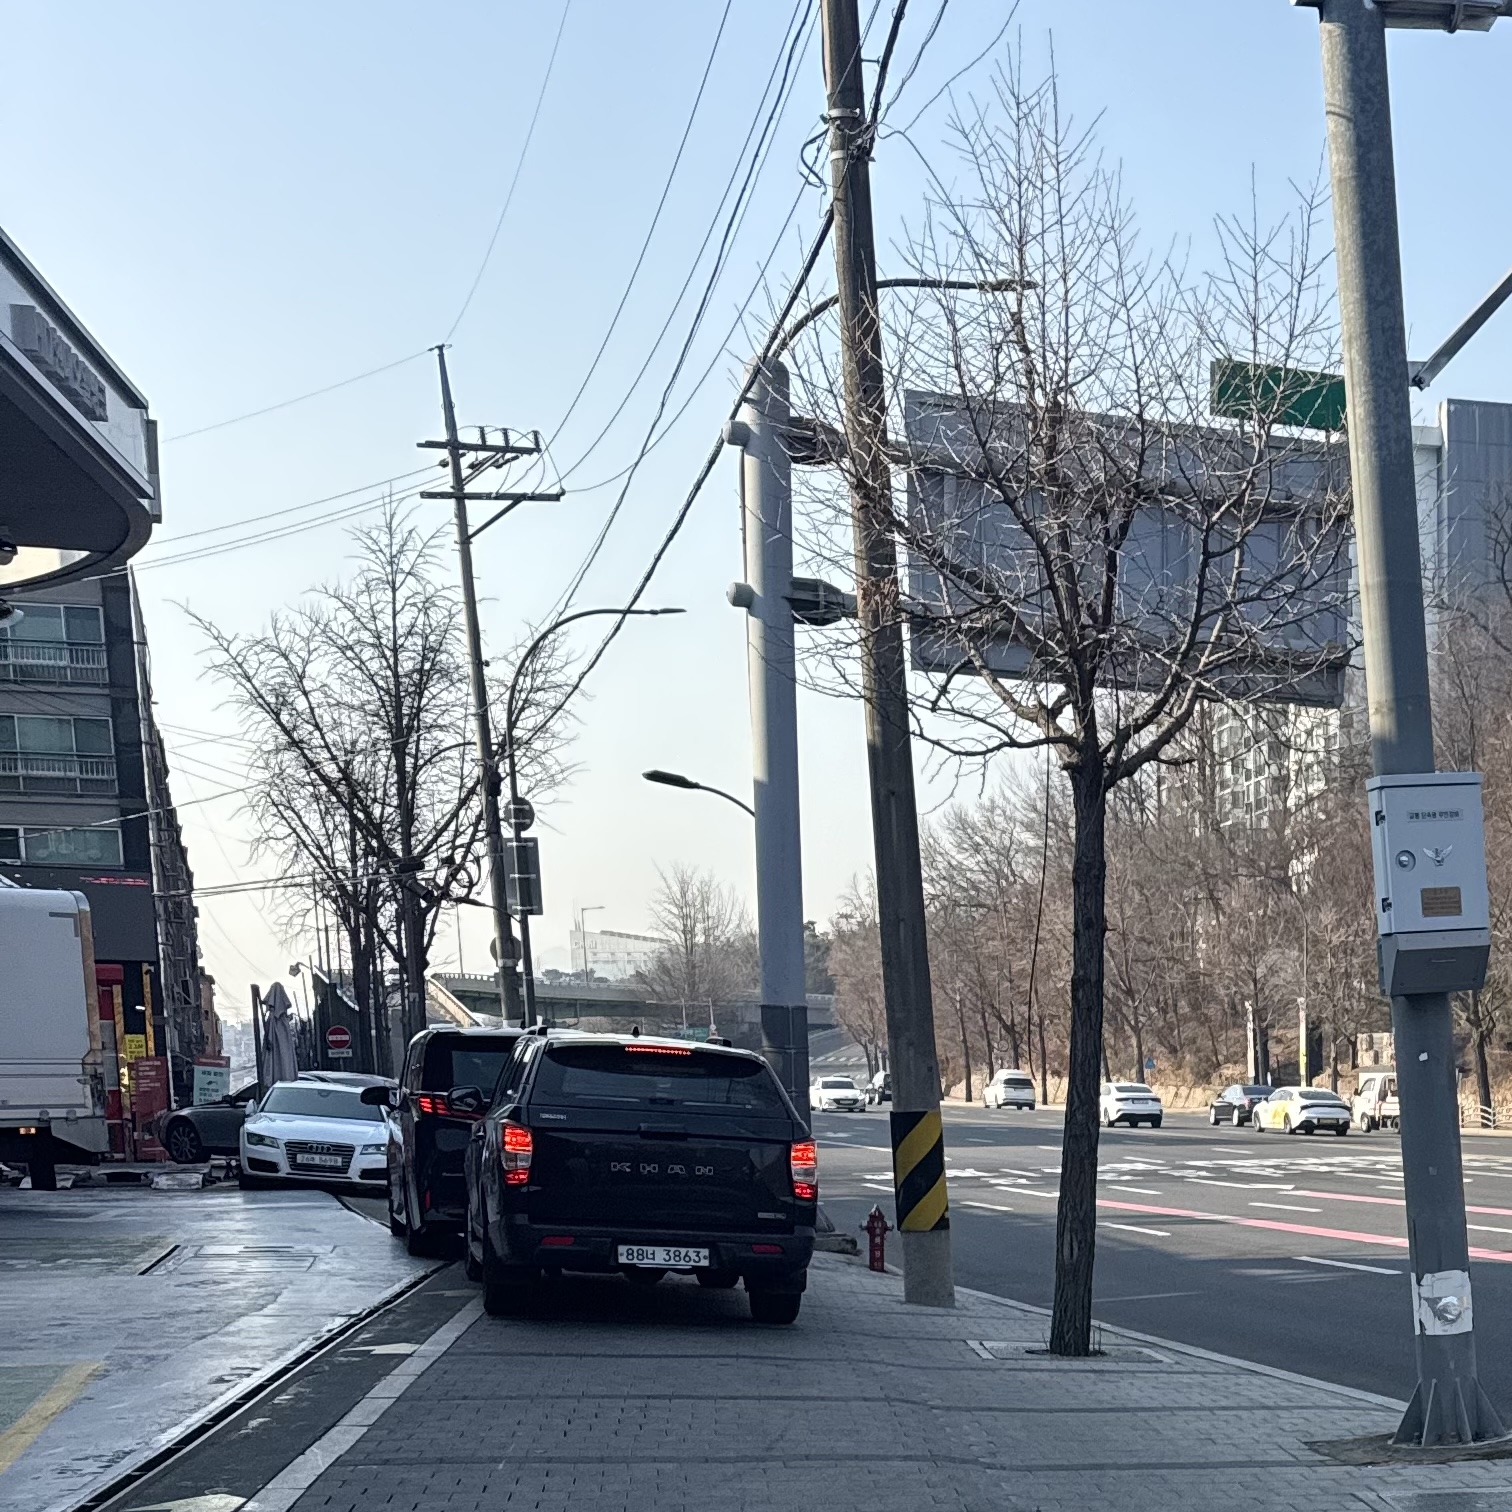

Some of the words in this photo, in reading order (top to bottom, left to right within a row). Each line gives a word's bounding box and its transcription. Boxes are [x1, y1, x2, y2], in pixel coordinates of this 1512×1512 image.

[610, 1161, 714, 1176] KHAN
[625, 1247, 656, 1262] 88너
[662, 1248, 702, 1264] 3863
